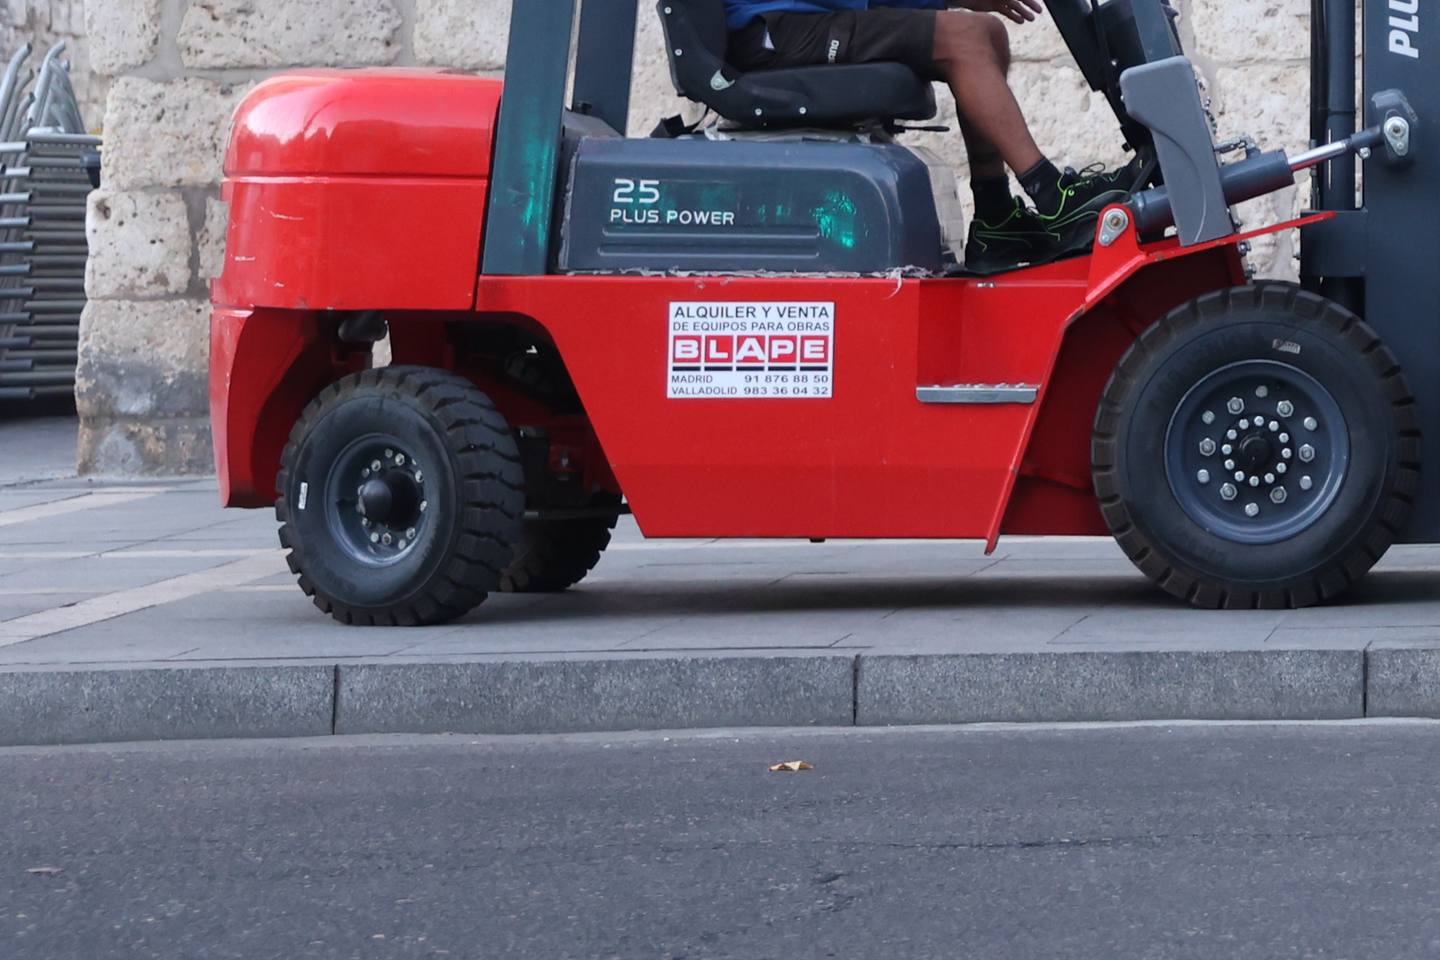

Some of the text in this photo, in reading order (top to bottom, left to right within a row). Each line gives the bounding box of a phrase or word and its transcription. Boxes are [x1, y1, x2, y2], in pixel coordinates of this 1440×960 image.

[613, 178, 660, 204] 25
[610, 209, 735, 225] PLUS POWER
[674, 306, 829, 319] ALQUILER Y VENTA
[673, 322, 830, 332] DE EQUIPOS PARA OBRAS
[674, 337, 826, 361] BLAPE
[671, 375, 829, 384] MADRID 91 876 88 50
[672, 386, 828, 395] VALLADOLID 983 36 04 32
